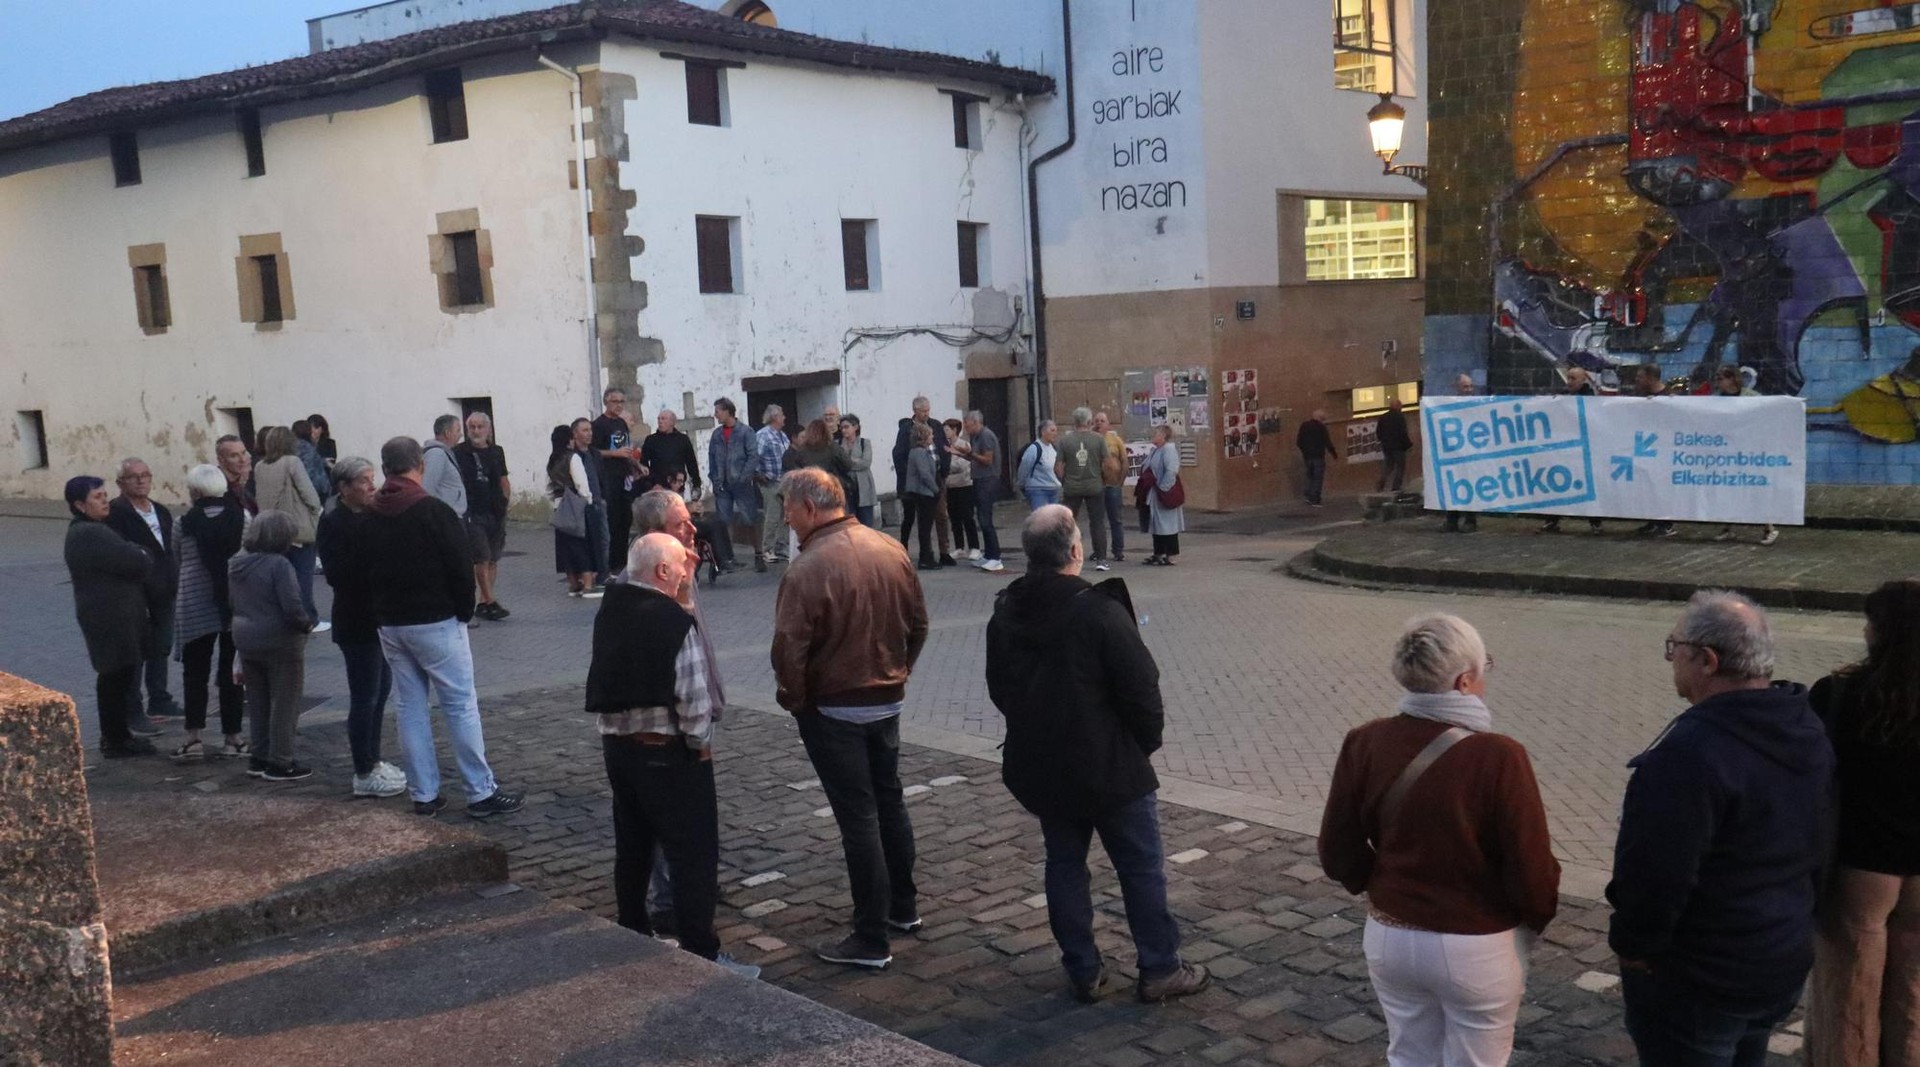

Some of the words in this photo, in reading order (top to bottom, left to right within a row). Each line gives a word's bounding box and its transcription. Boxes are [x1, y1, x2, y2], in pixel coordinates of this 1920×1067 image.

[1112, 44, 1164, 76] aire
[1092, 88, 1182, 125] garbiak
[1113, 136, 1168, 168] bira
[1102, 179, 1186, 211] nazan
[1438, 403, 1551, 452] Behin
[1674, 431, 1728, 447] Bakea.
[1673, 450, 1792, 469] Konponbidea.
[1446, 458, 1584, 506] betiko.
